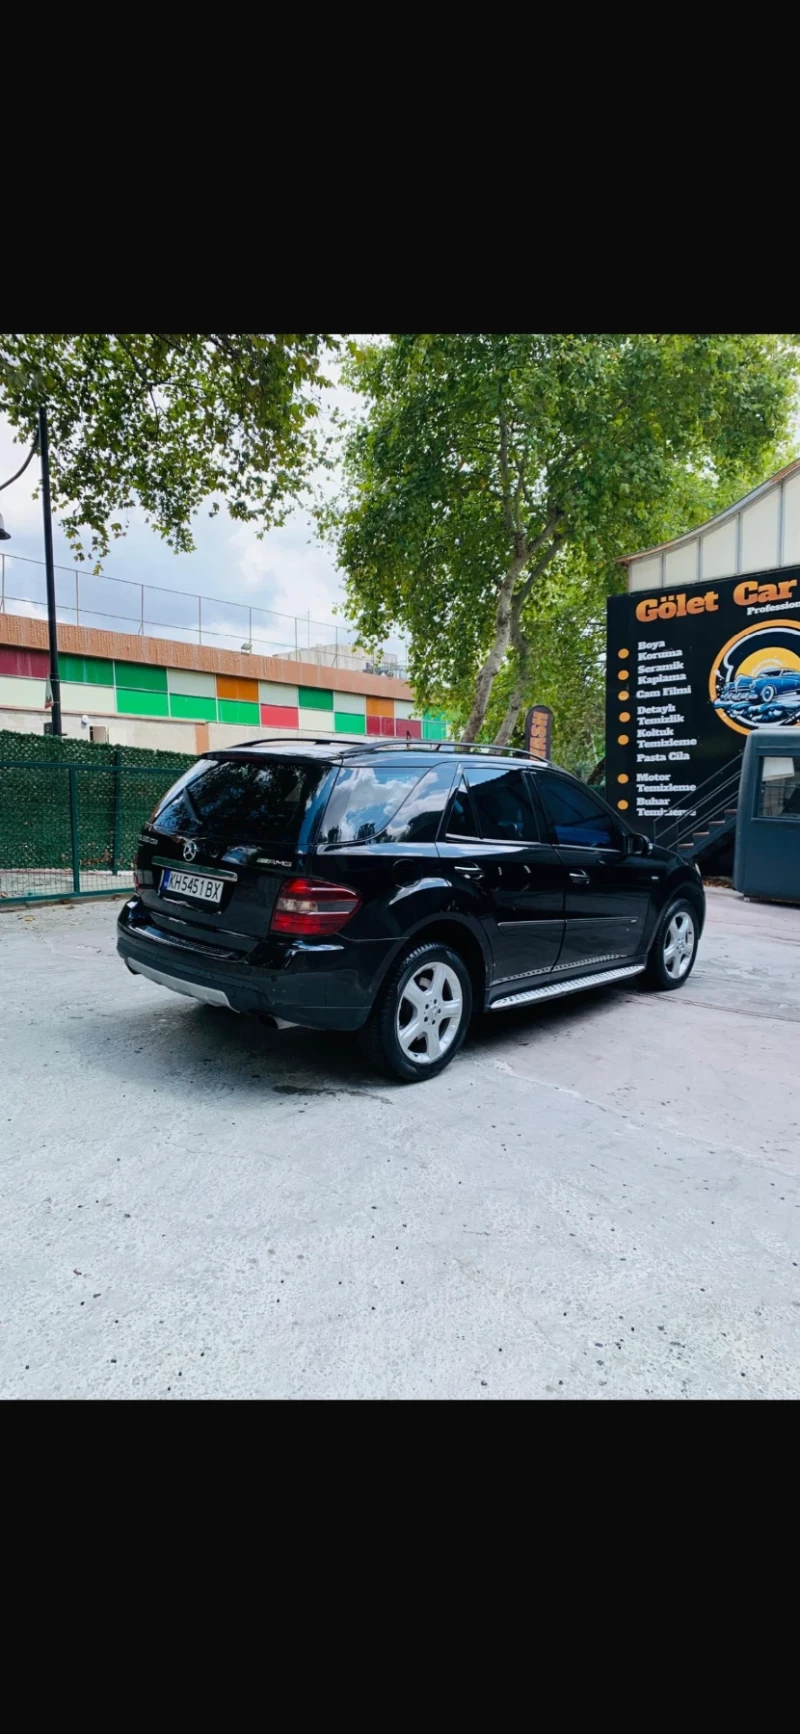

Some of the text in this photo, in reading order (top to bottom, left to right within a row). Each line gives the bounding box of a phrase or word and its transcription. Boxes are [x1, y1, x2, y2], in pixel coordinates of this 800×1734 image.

[636, 579, 797, 622] Gölet Car
[637, 640, 666, 650] Boya
[637, 650, 683, 661] Koruma
[637, 661, 684, 674] Seramik
[637, 673, 687, 685] Kaplama
[636, 685, 692, 699] Cam Filmi
[636, 714, 685, 726] Temizlik
[636, 727, 674, 738] Koltuk
[636, 738, 697, 749] Temizleme
[636, 751, 690, 762] Pasta Cila
[636, 773, 671, 782] Motor
[636, 783, 697, 793] Temizleme
[636, 797, 671, 806] Buhar
